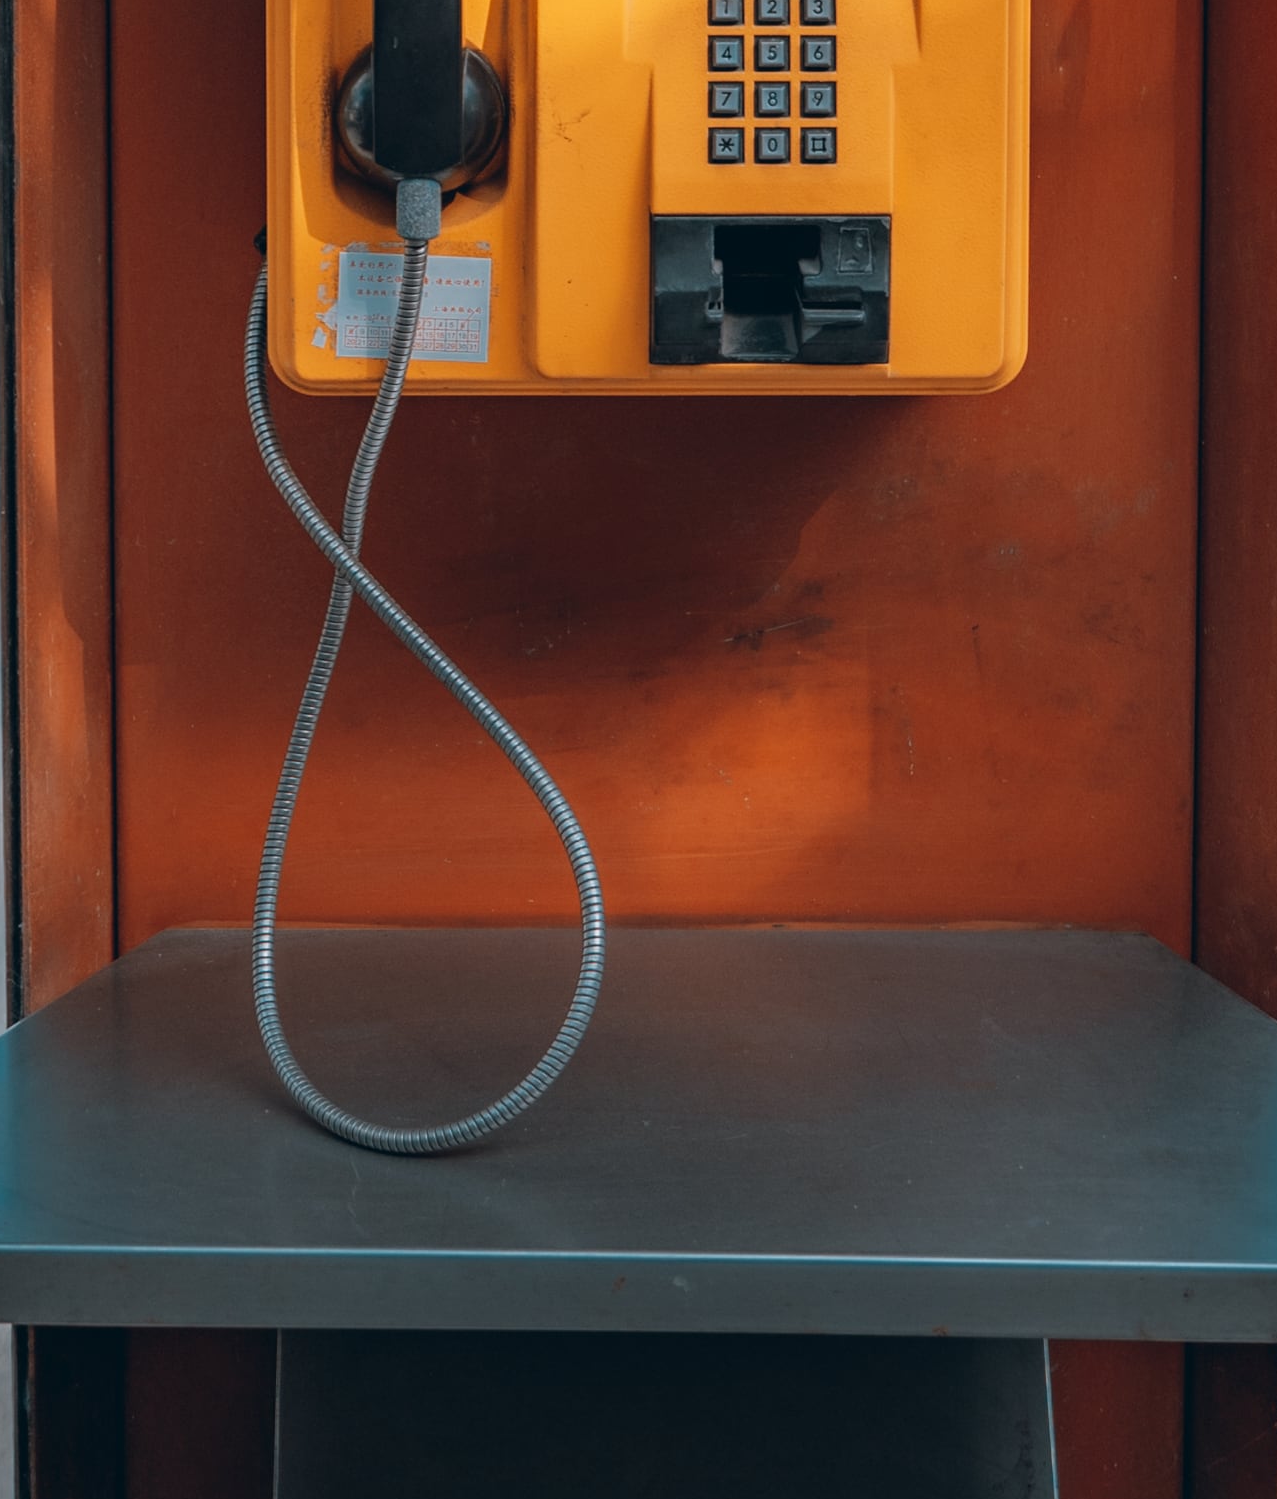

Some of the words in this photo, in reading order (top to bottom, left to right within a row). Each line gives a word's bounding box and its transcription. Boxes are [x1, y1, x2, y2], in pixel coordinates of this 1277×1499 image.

[723, 0, 729, 14] 1
[767, 0, 777, 14] 2
[813, 0, 824, 14] 3
[721, 46, 732, 60] 4
[767, 45, 777, 61] 5
[814, 45, 824, 61] 6
[721, 91, 732, 106] 7
[768, 91, 778, 107] 8
[813, 90, 824, 106] 9
[768, 137, 778, 153] 0
